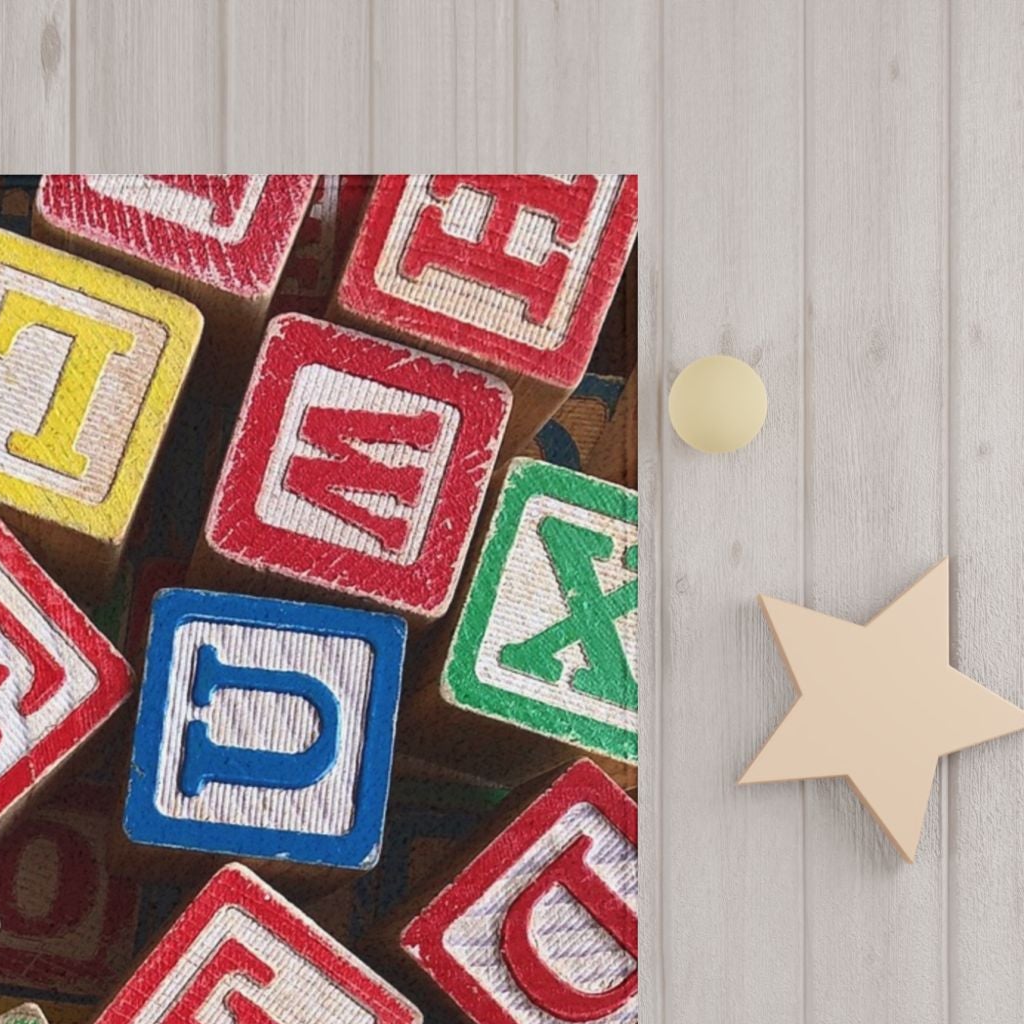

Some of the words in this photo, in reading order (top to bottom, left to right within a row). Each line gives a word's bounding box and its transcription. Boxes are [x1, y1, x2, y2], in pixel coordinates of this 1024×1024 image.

[282, 406, 442, 555] W
[498, 516, 637, 711] X
[178, 643, 342, 798] U
[500, 833, 637, 1023] D
